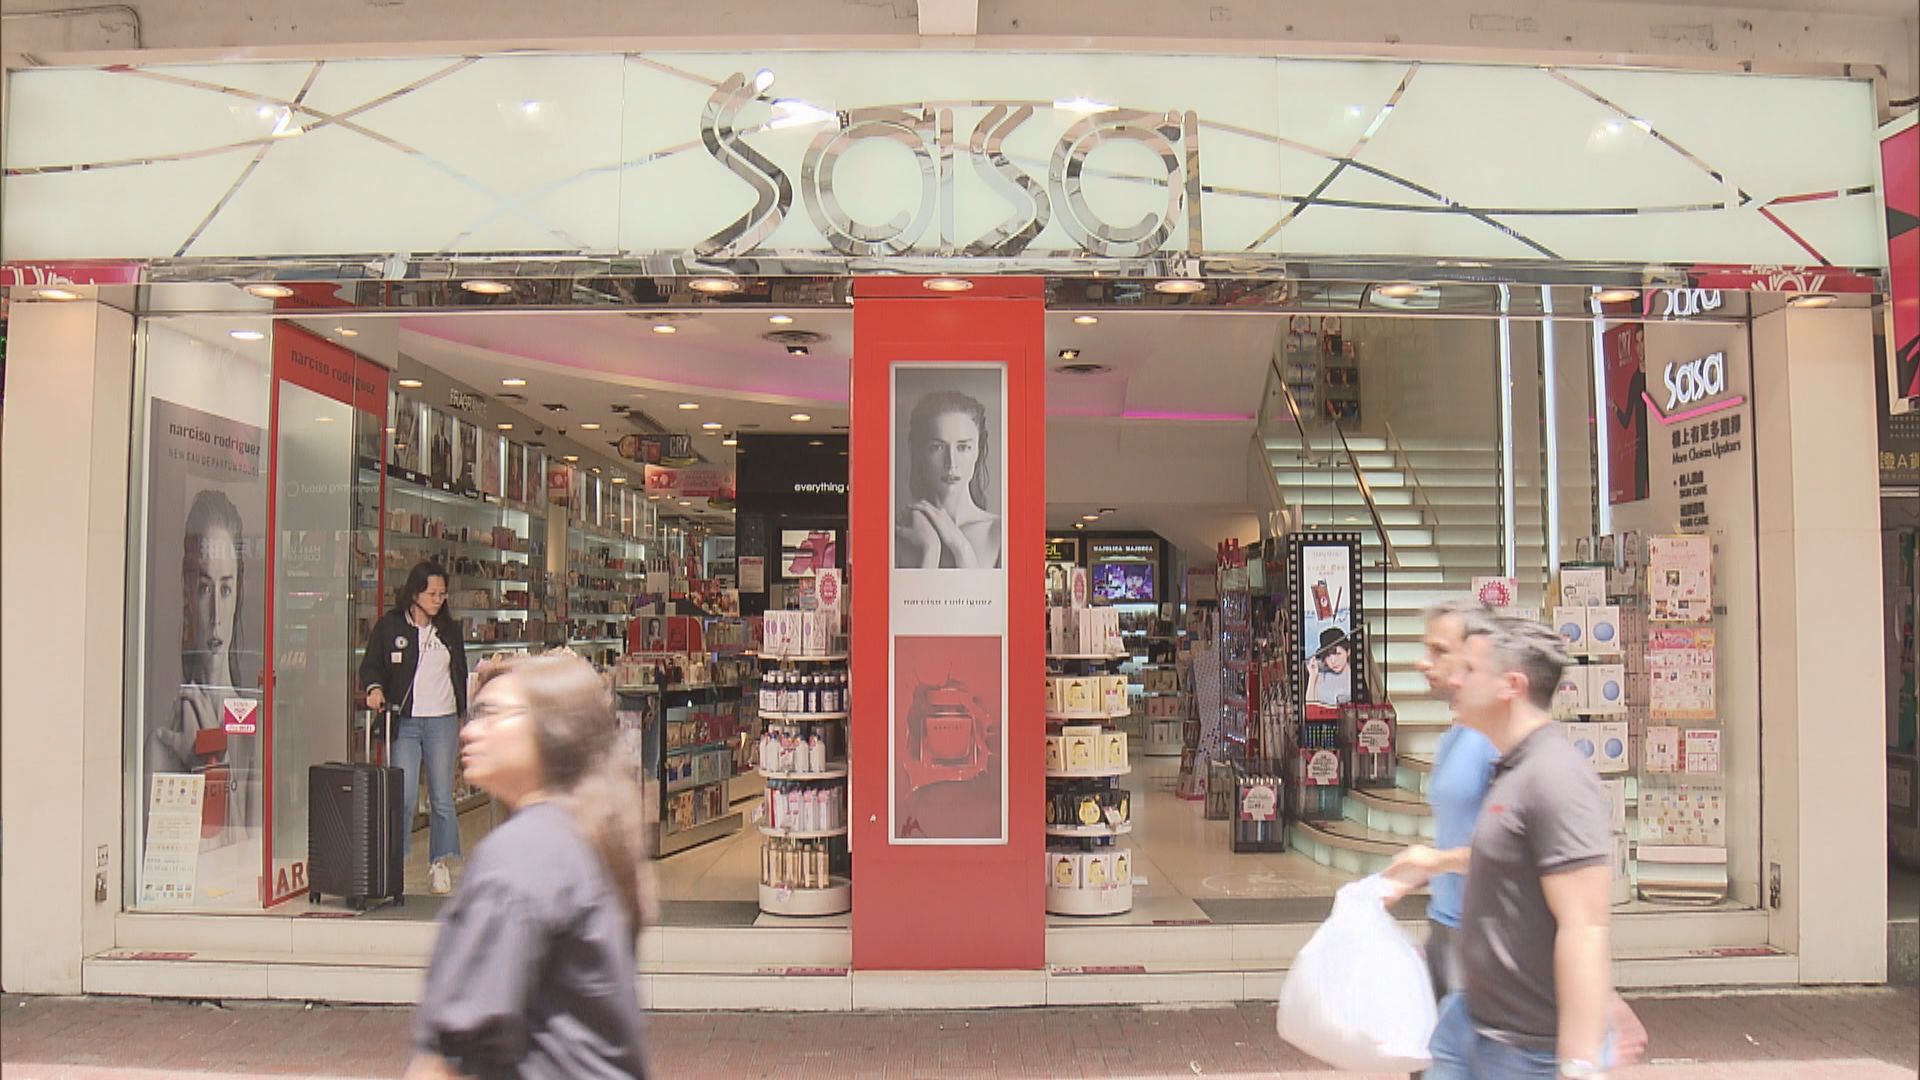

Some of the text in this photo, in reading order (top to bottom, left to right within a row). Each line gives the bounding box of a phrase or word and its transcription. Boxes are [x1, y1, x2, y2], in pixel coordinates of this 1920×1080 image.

[291, 350, 329, 375] narciso
[169, 423, 261, 456] narciso rodriguez
[1672, 440, 1741, 465] More Choices Upstairs
[794, 481, 845, 494] everything
